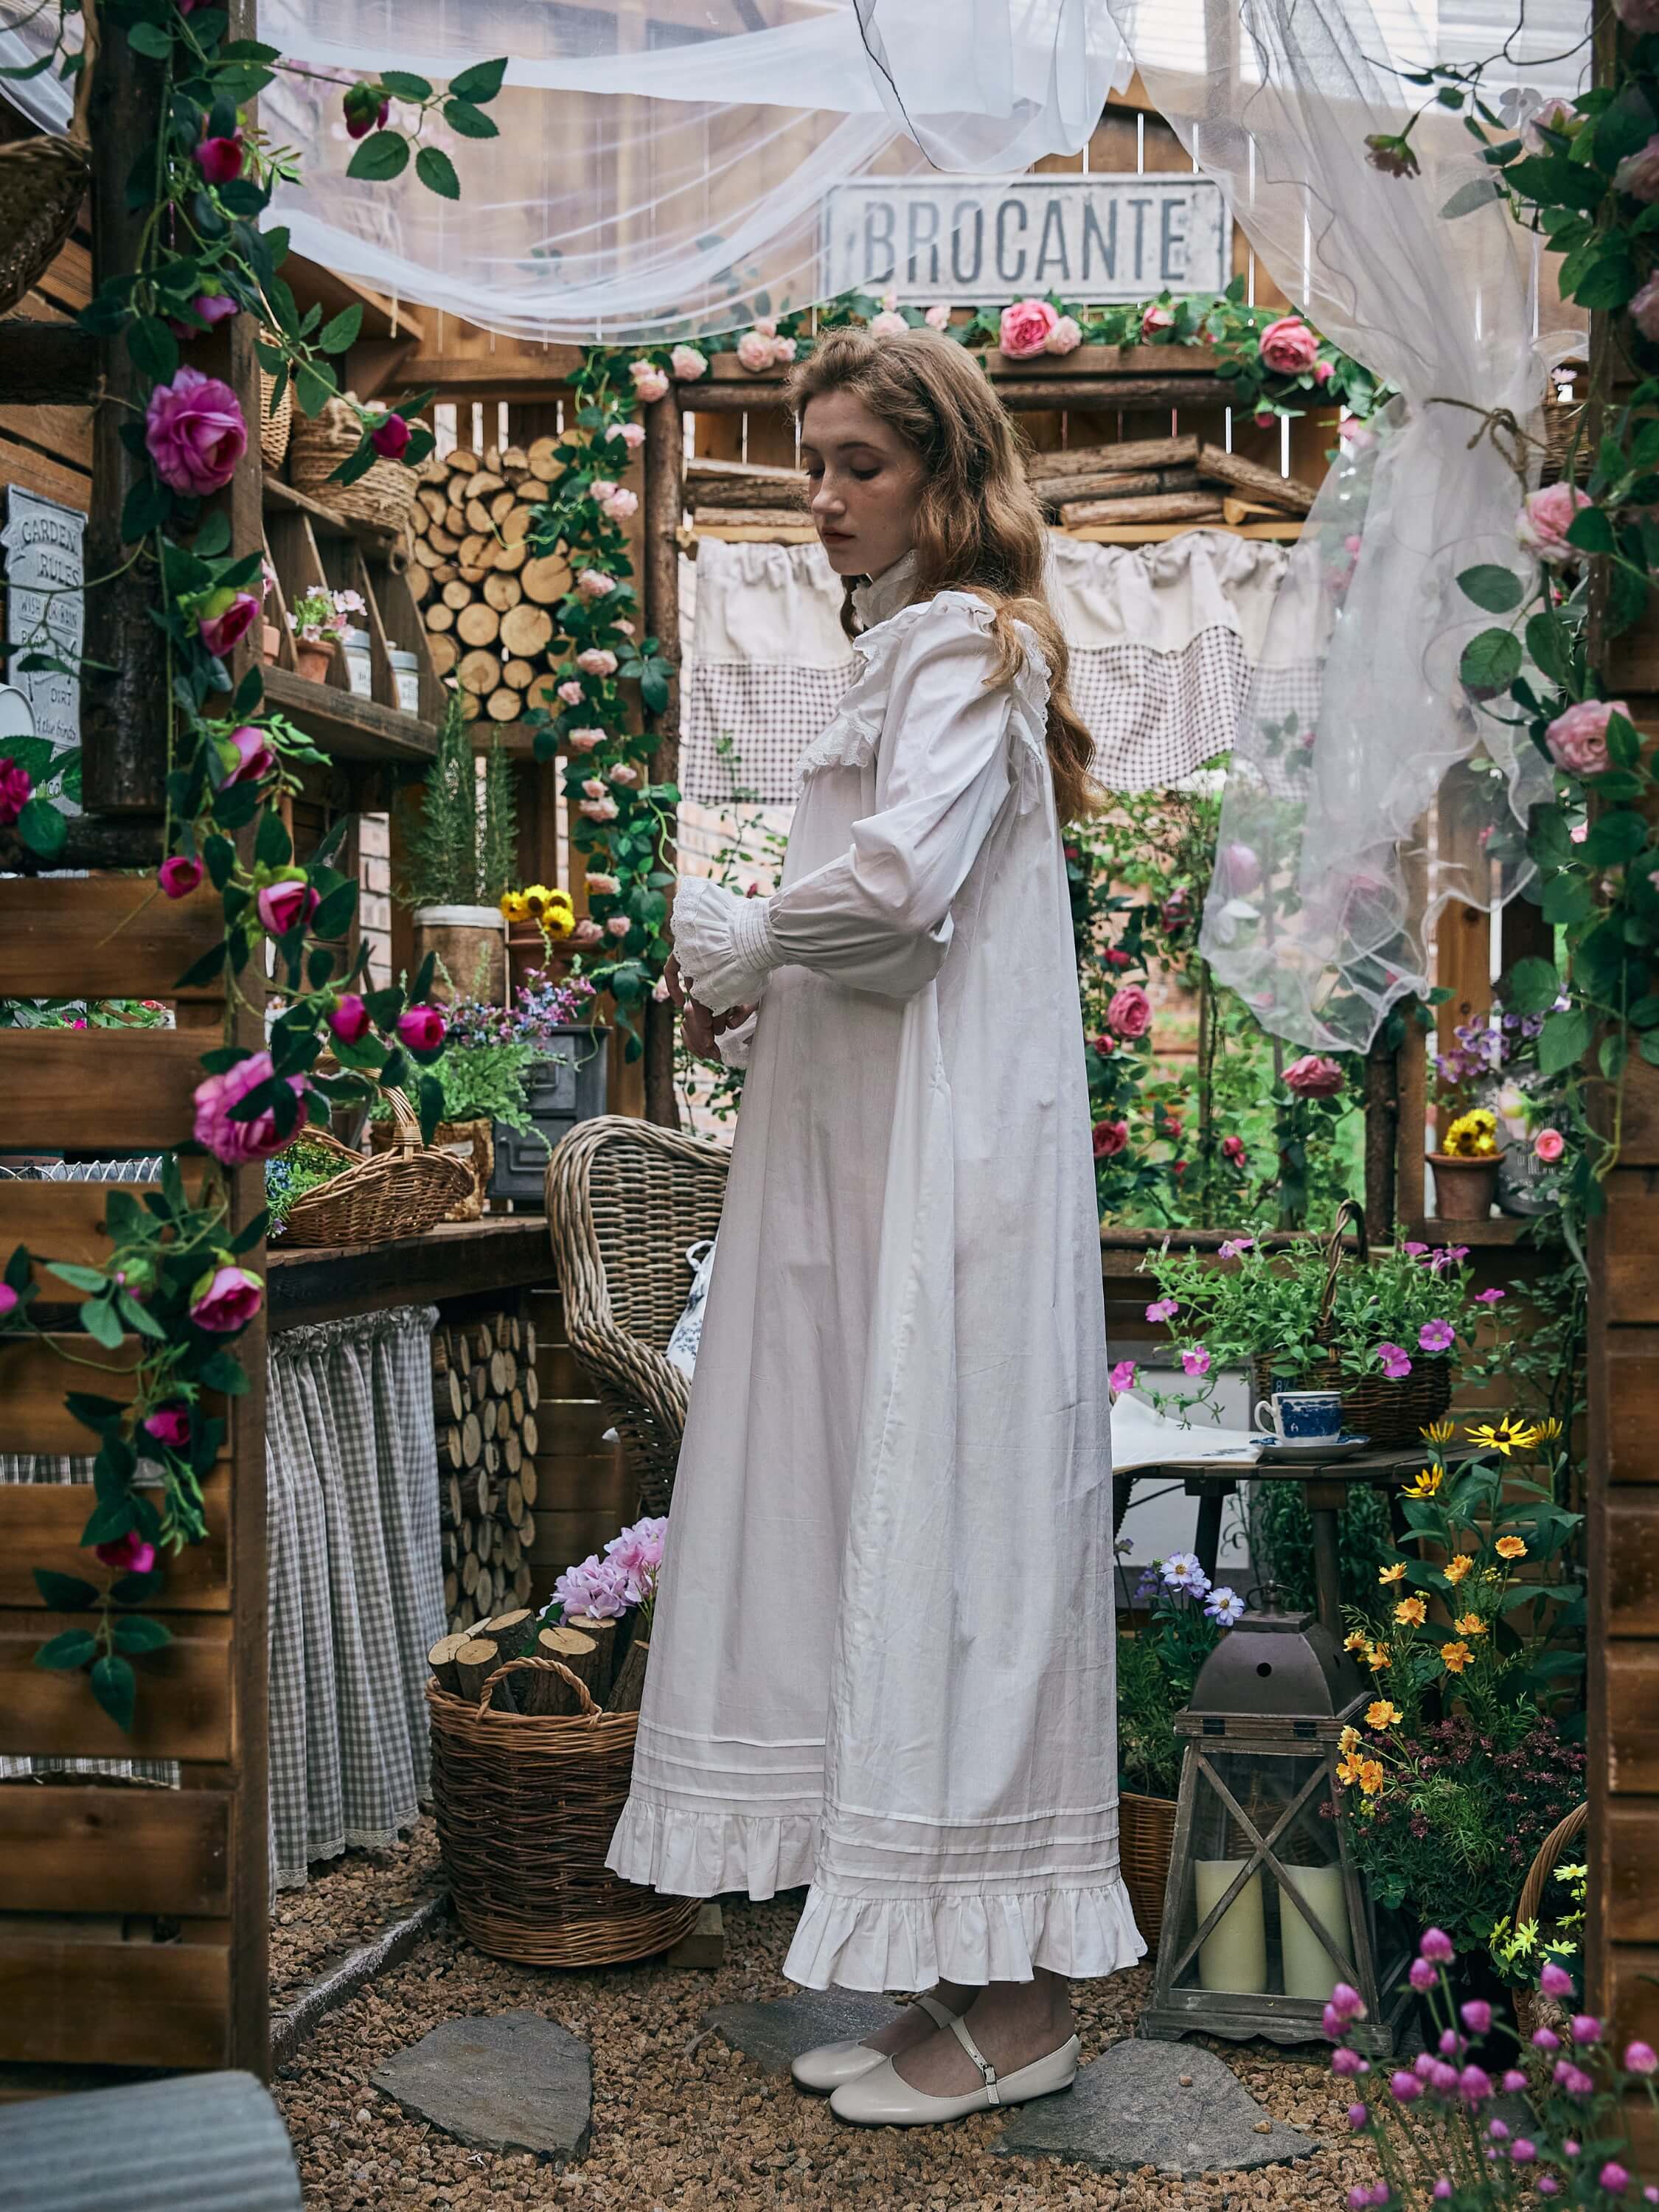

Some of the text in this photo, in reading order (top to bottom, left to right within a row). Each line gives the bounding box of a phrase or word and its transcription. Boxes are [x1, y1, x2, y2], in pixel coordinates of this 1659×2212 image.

[864, 198, 1186, 284] BROCANTE
[22, 519, 78, 557] GARDEN
[38, 554, 80, 588] RULES
[51, 687, 72, 706] DIRT
